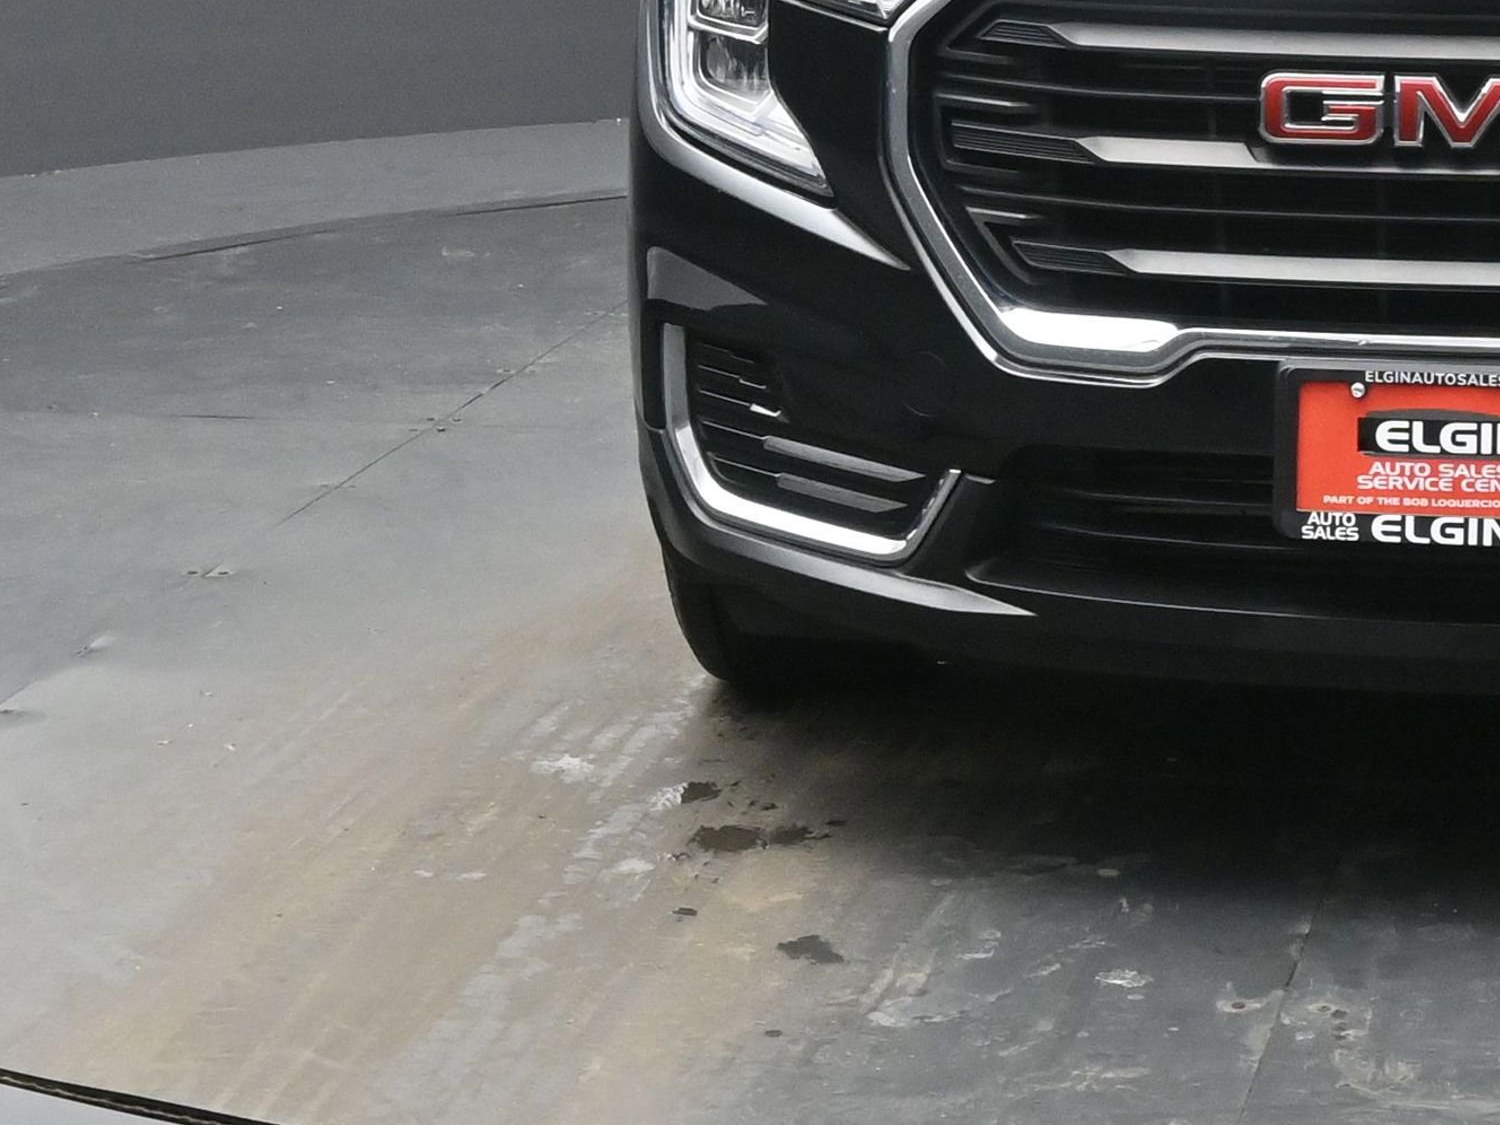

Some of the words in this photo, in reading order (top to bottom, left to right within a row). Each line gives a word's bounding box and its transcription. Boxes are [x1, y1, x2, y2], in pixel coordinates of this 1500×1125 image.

[1369, 462, 1430, 476] AUTO
[1357, 476, 1453, 491] SERVICE
[1323, 495, 1354, 505] PART
[1357, 496, 1374, 506] OF
[1377, 496, 1400, 506] THE
[1403, 497, 1428, 507] BOB
[1307, 512, 1356, 526] AUTO
[1301, 525, 1359, 541] SALES
